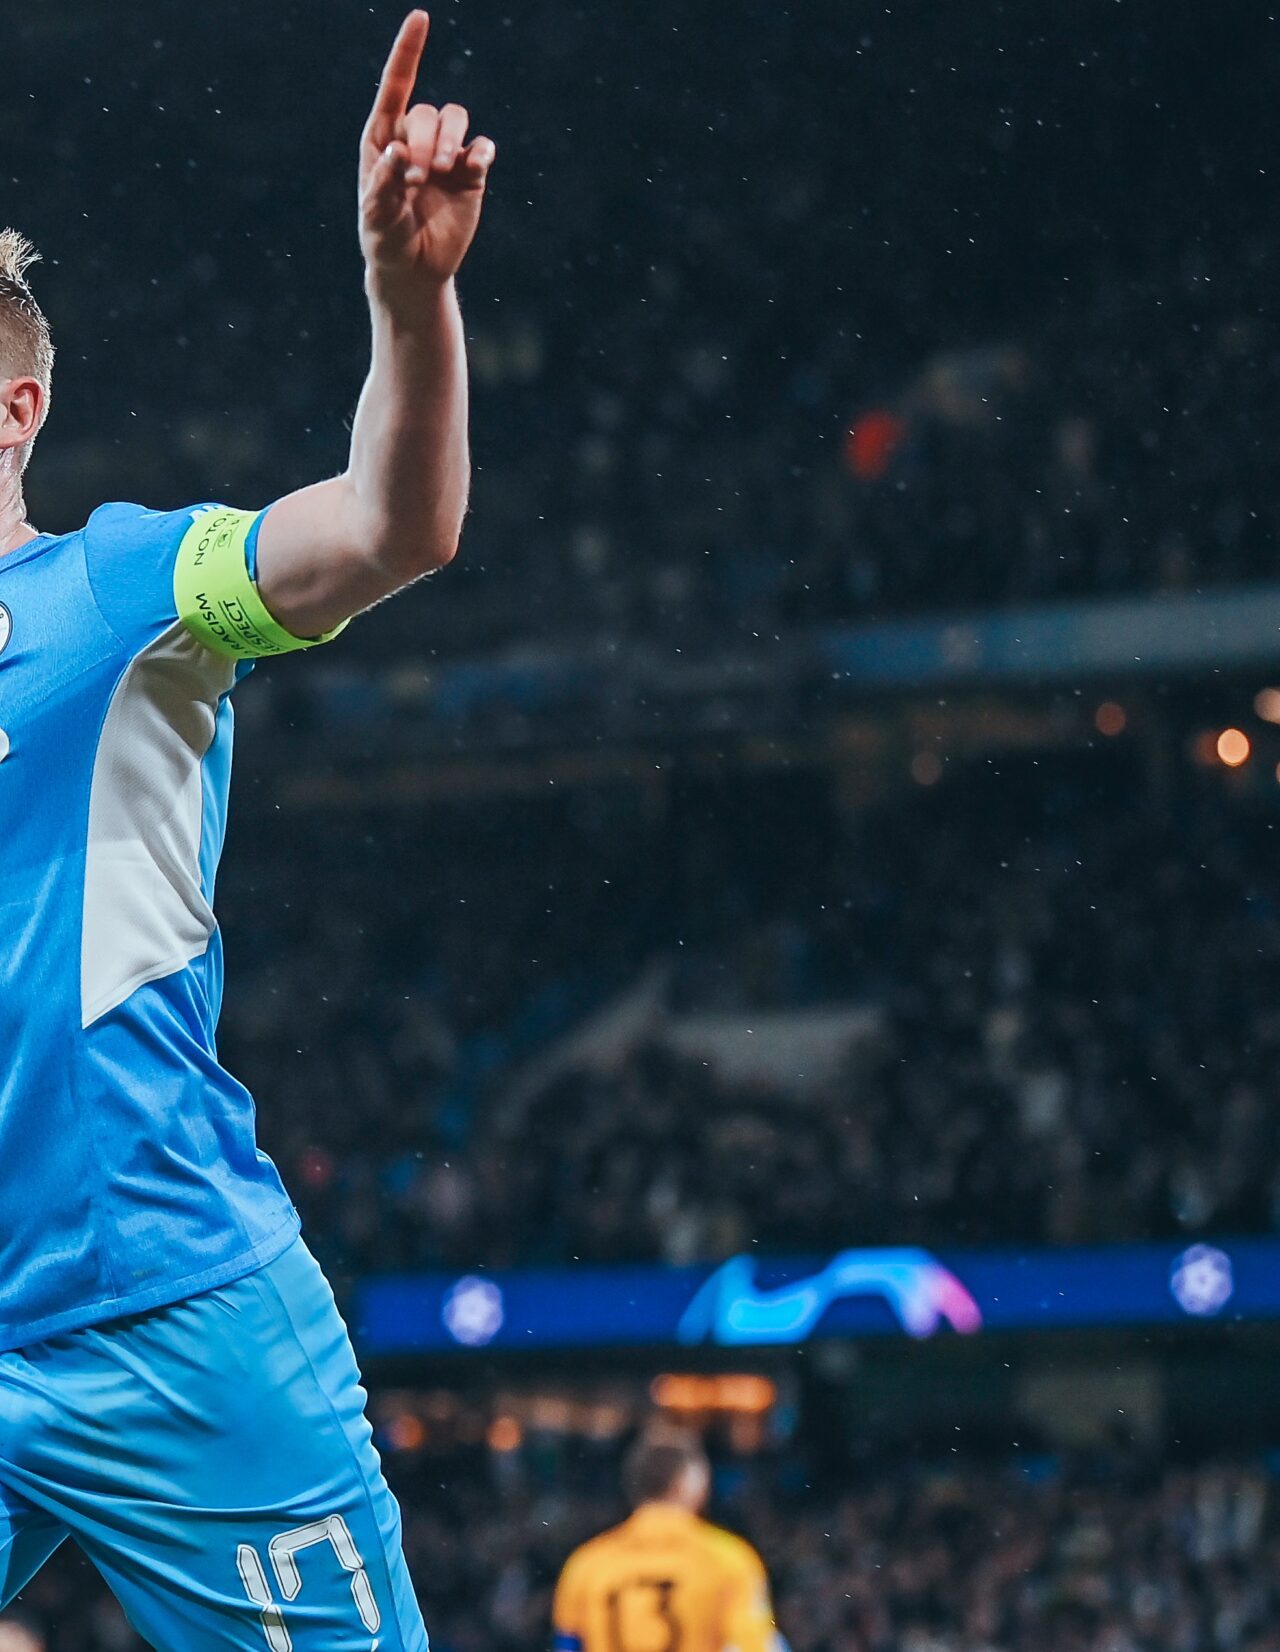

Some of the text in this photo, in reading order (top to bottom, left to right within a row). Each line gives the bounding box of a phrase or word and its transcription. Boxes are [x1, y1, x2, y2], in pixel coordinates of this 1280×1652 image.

[194, 517, 227, 566] NO TO
[195, 592, 245, 650] RACISM
[236, 1513, 381, 1652] 17
